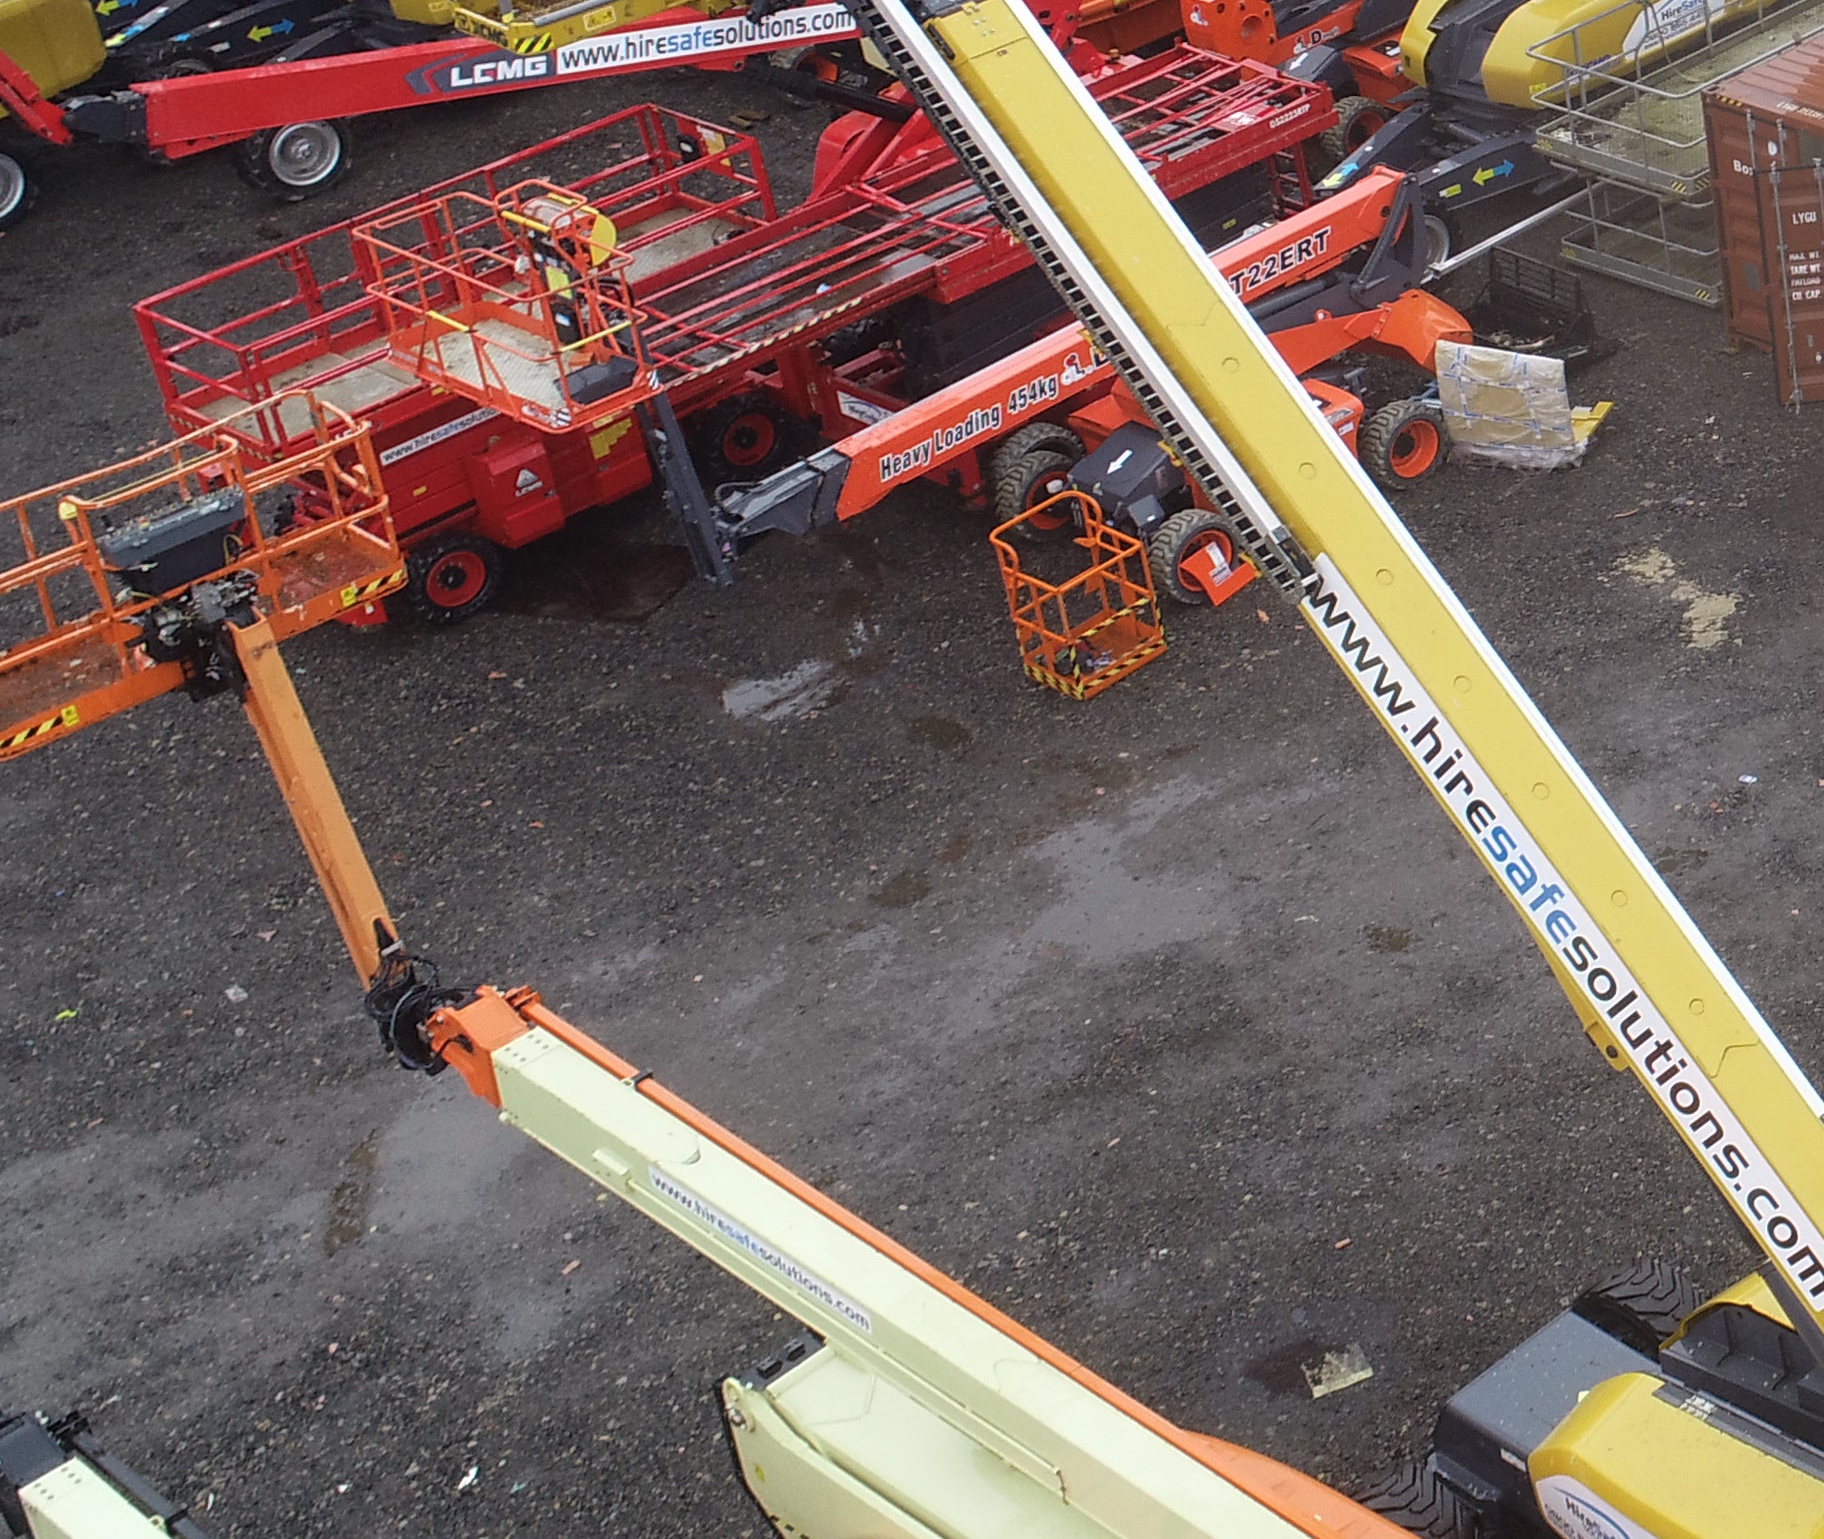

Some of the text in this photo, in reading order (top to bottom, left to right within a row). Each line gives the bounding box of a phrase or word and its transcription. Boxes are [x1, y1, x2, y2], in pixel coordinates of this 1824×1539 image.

[561, 10, 852, 69] www.hiresafesolutions.com
[1792, 211, 1817, 225] LYGU
[1006, 373, 1059, 415] 454kg
[879, 403, 1001, 482] Heavy Loading
[652, 1173, 870, 1331] www.hiresafesolutions.com
